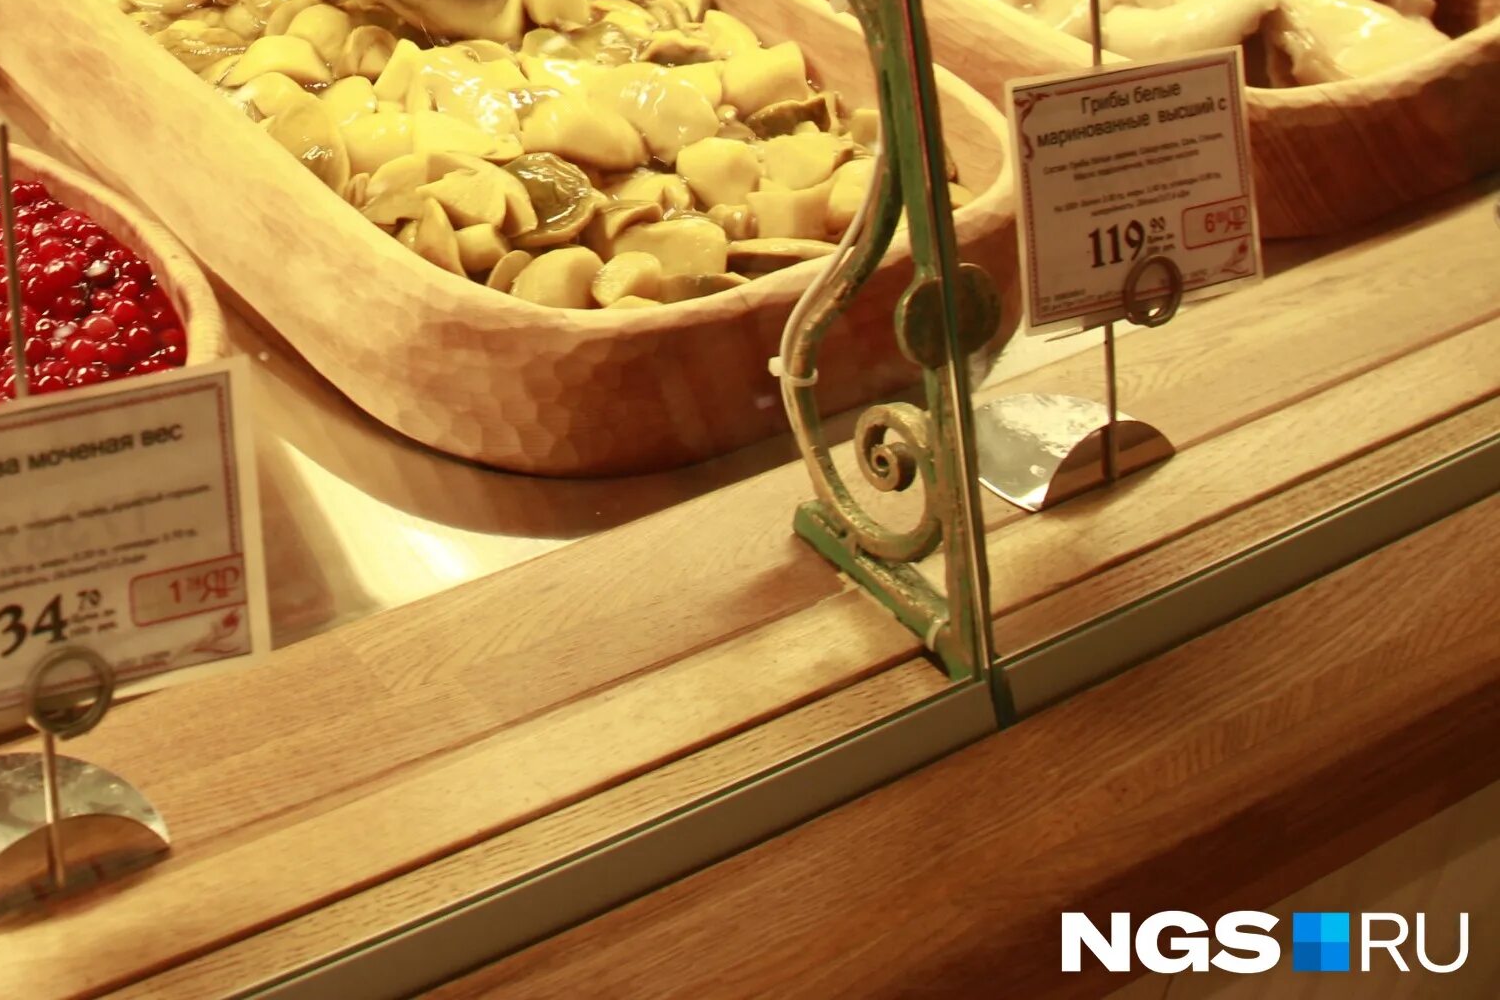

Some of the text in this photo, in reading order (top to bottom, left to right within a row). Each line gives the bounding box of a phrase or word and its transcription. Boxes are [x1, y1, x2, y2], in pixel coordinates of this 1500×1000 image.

[1037, 111, 1151, 148] маринованные
[1158, 96, 1216, 124] высший
[1080, 81, 1182, 116] Грибы белые
[1087, 219, 1146, 269] 119
[27, 434, 136, 471] моченая
[141, 420, 184, 449] вес
